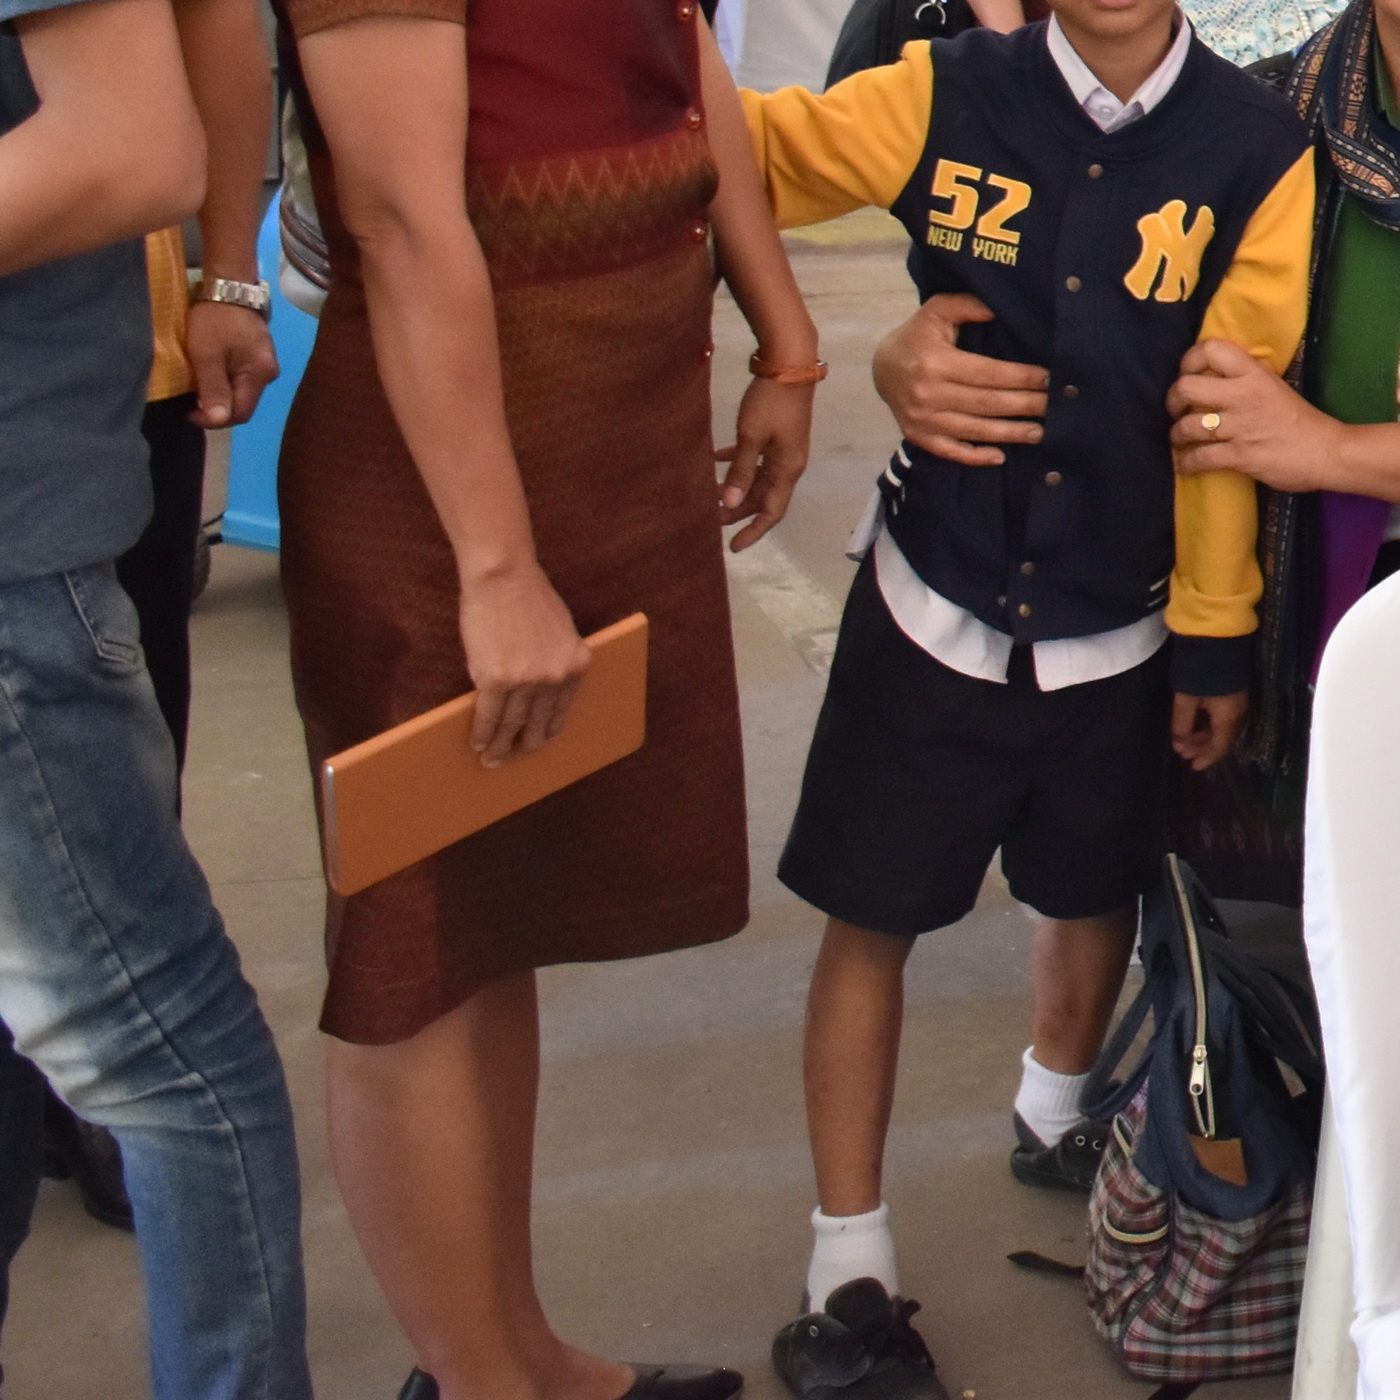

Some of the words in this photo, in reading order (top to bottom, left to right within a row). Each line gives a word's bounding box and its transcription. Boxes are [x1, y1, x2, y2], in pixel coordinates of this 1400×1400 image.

[927, 158, 1032, 244] 52
[926, 225, 963, 252] NEW
[972, 237, 1019, 268] YORK
[1123, 199, 1216, 303] NY
